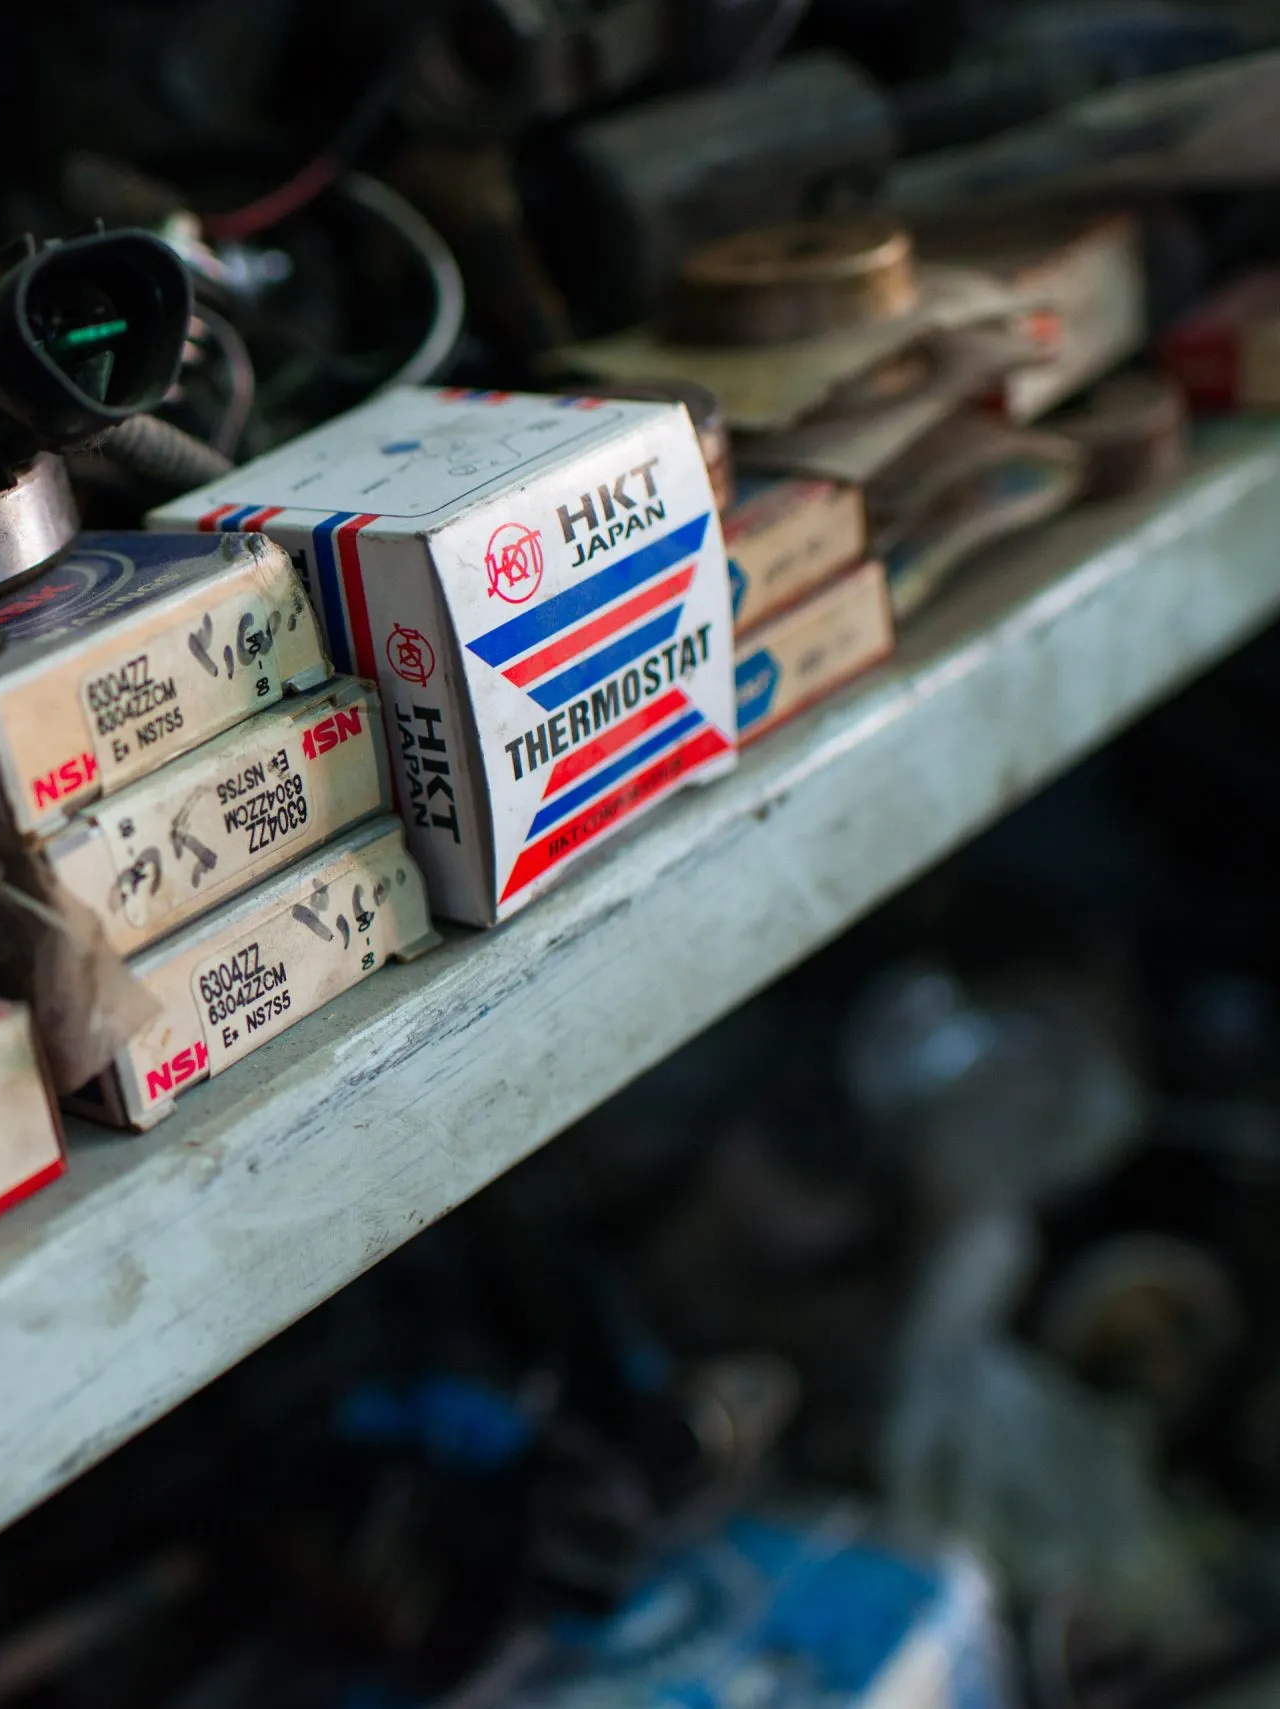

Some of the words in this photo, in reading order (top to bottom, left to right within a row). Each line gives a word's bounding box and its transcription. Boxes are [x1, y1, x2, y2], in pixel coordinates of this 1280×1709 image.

[556, 456, 660, 544] HKT
[571, 499, 667, 568] JAPAN
[87, 652, 154, 714] 6304ZZ
[95, 676, 178, 738] 6304ZZCM
[504, 620, 713, 783] THERMOSTAT
[135, 706, 185, 750] NS7S5
[216, 761, 267, 806] NS7S5
[393, 702, 431, 829] JAPAN
[412, 704, 462, 845] HKT
[223, 773, 304, 835] 6304ZZCM
[244, 795, 308, 855] 6304ZZ
[199, 942, 266, 1004] 6304ZZ
[208, 961, 288, 1026] 6304ZZCM
[245, 989, 292, 1034] NS7S5
